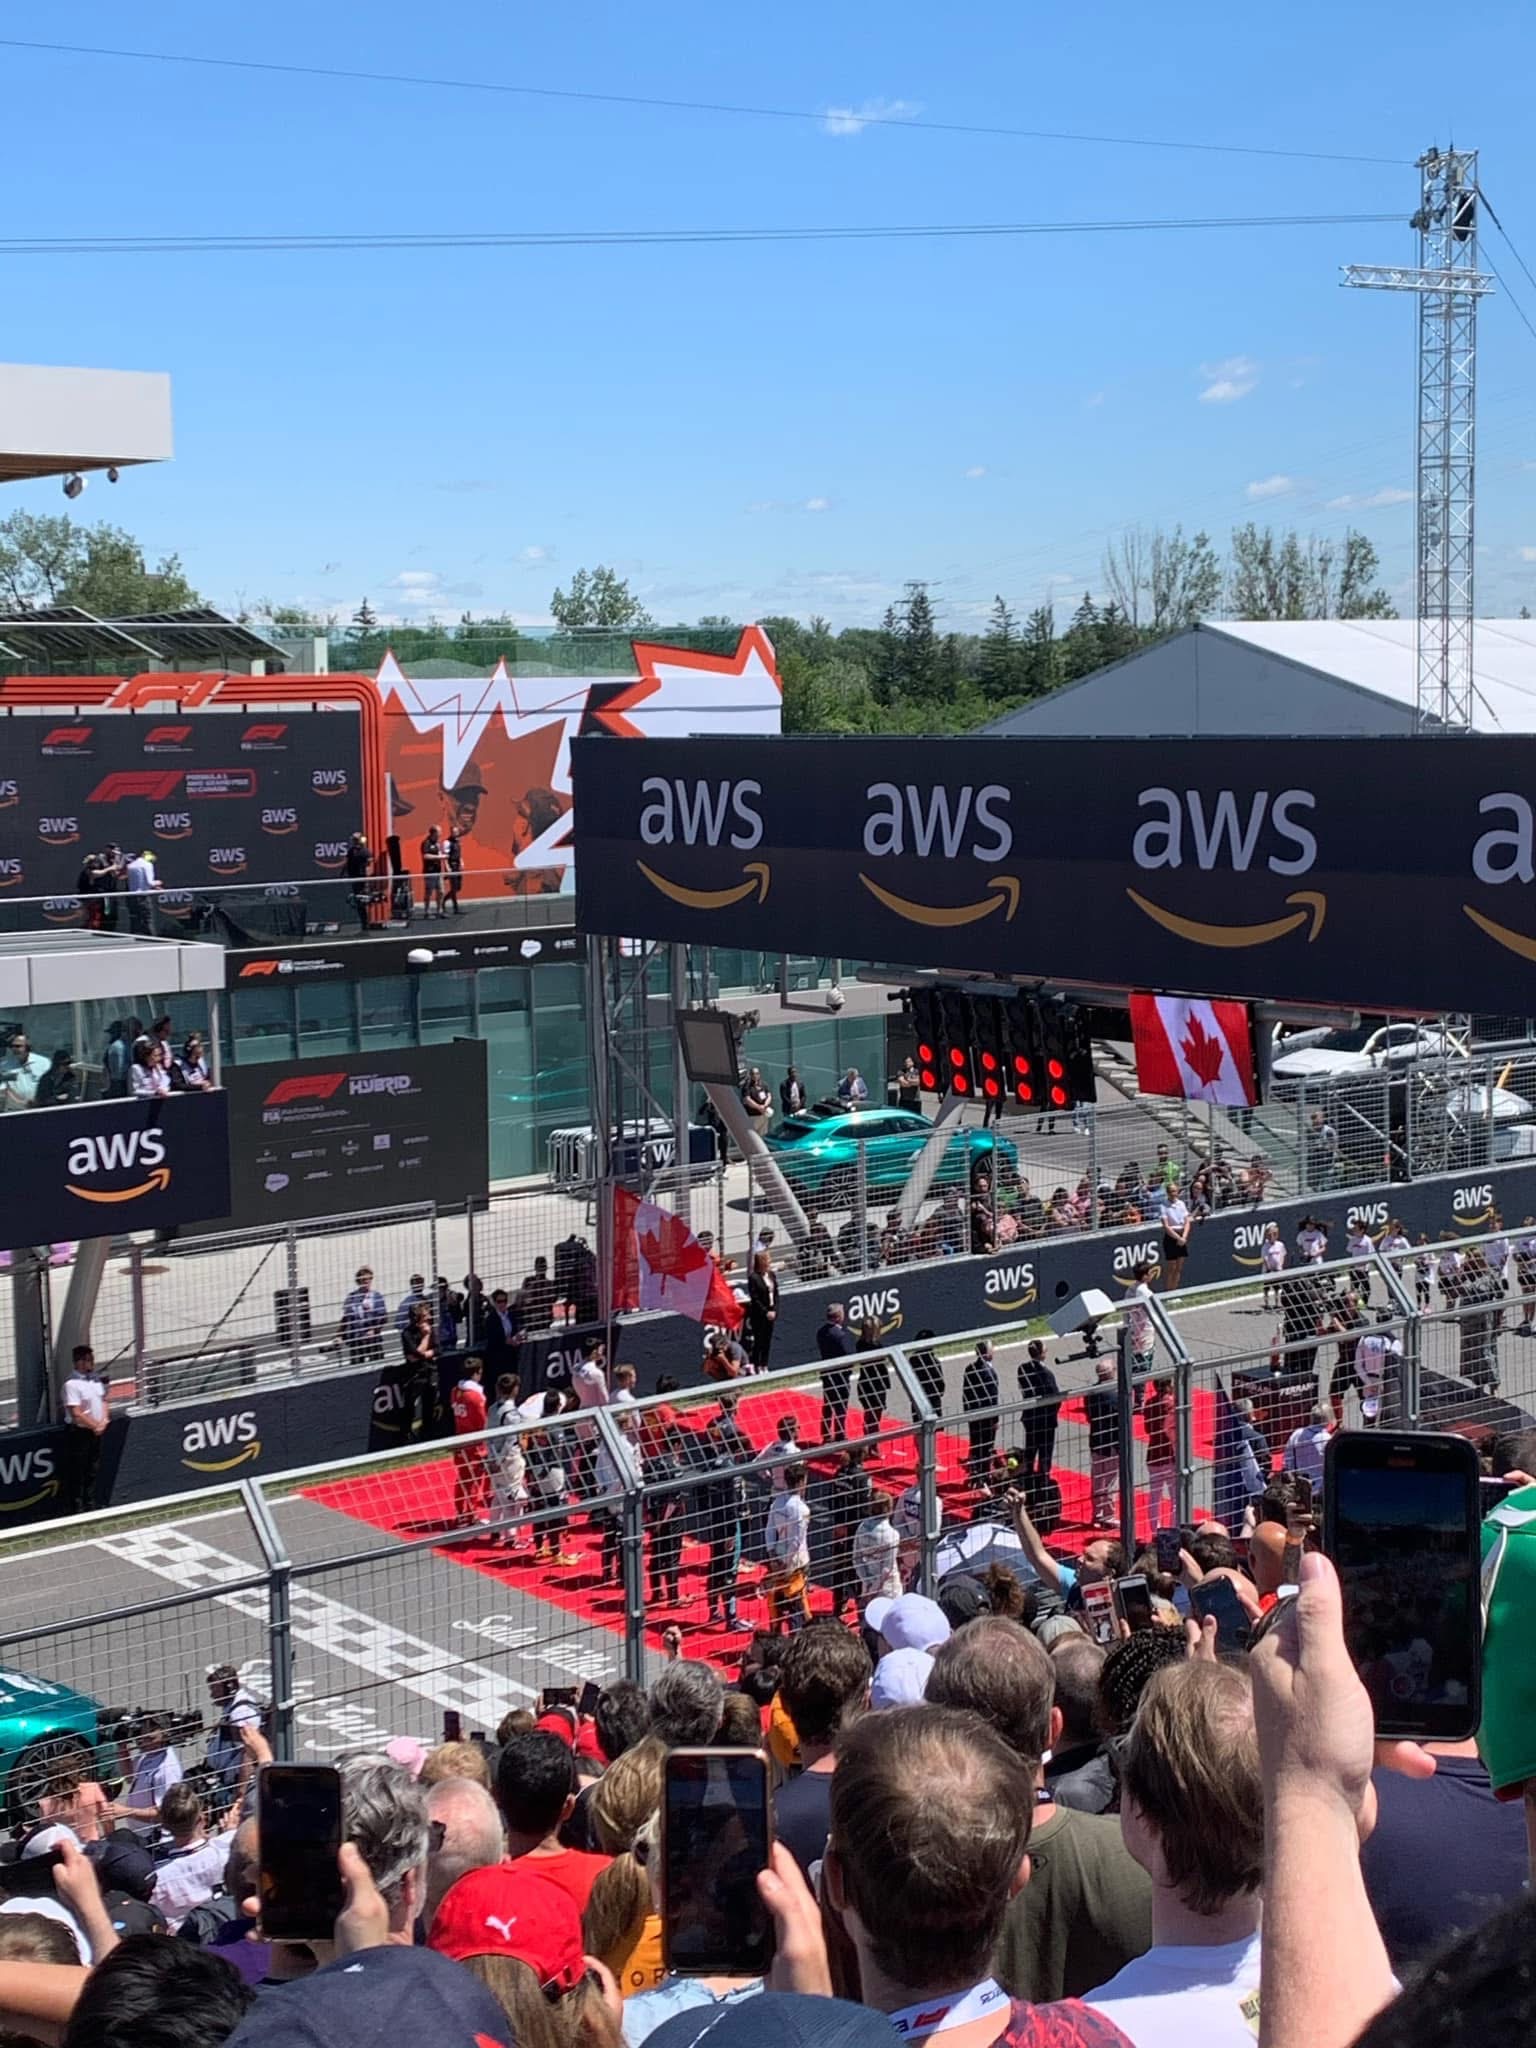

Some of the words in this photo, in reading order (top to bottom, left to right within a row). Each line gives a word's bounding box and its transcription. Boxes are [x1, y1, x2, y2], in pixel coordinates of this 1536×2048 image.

[312, 770, 346, 784] aws
[39, 817, 78, 833] aws
[154, 813, 191, 829] aws
[261, 808, 297, 823] aws
[638, 776, 763, 851] aws
[863, 782, 1013, 863] aws
[1132, 788, 1317, 876] aws
[209, 848, 246, 863] aws
[315, 842, 348, 857] aws
[0, 858, 21, 874] ws
[349, 1075, 411, 1096] HYBRID
[68, 1127, 166, 1176] aws
[1453, 1184, 1493, 1211] aws
[1347, 1202, 1388, 1229] aws
[1113, 1241, 1160, 1270] aws
[984, 1263, 1035, 1294] aws
[848, 1288, 901, 1321] aws
[183, 1411, 258, 1453] aws
[0, 1448, 55, 1486] ws
